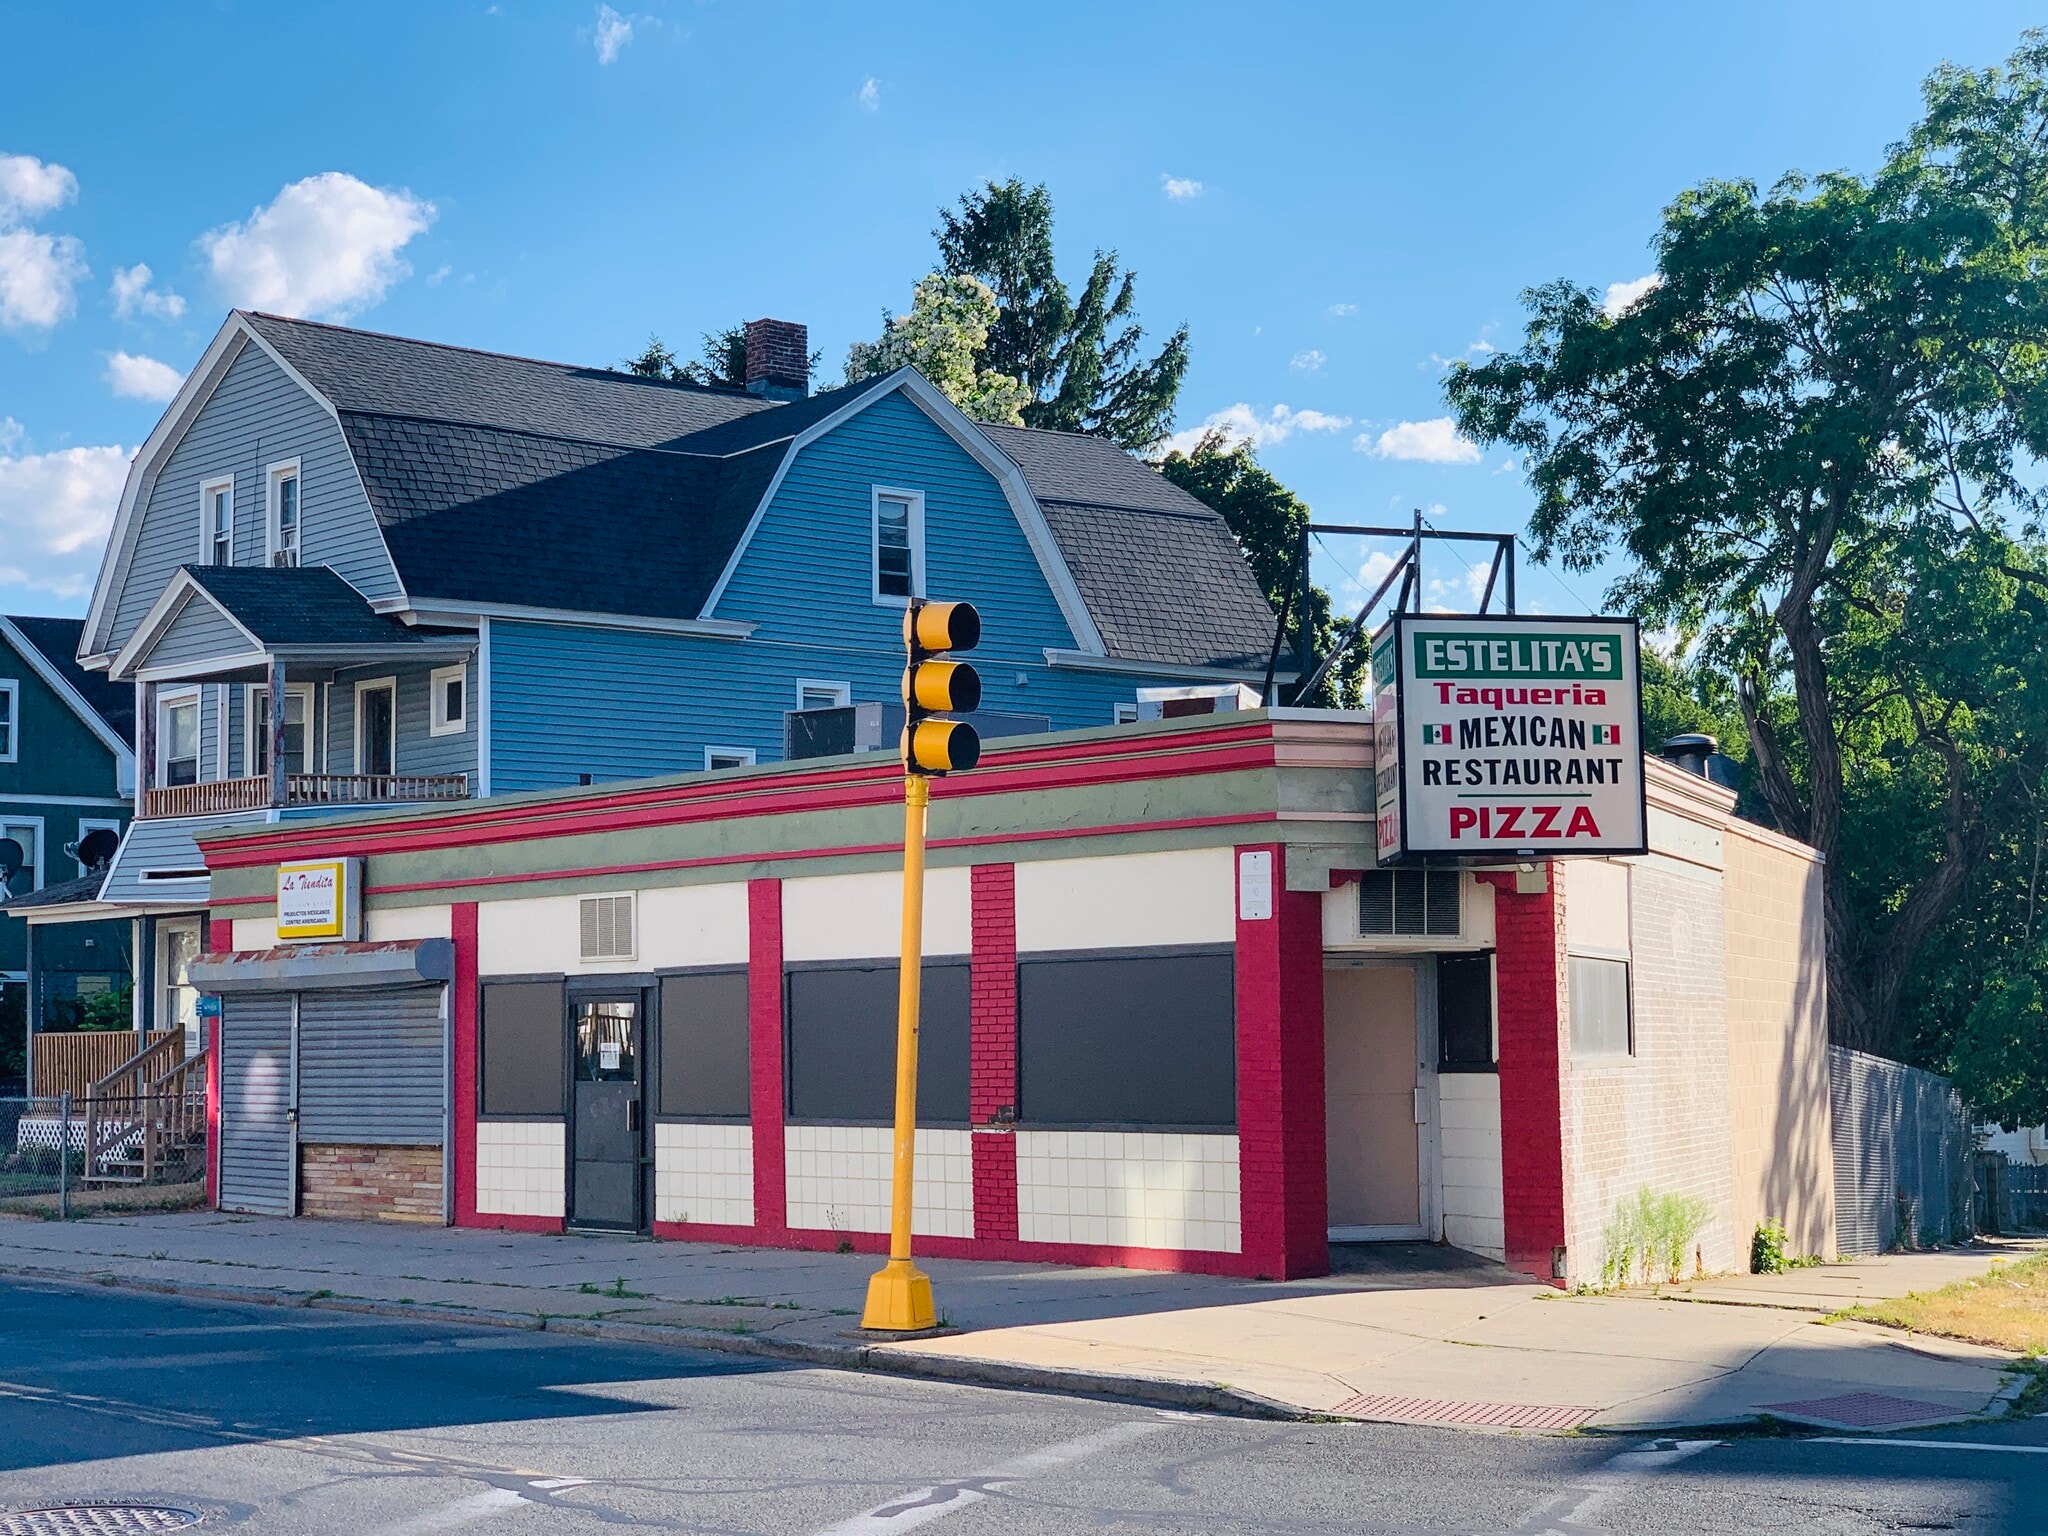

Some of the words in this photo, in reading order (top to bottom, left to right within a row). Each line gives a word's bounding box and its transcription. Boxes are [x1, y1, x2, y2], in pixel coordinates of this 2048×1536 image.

[1425, 639, 1612, 672] ESTELITA'S
[1433, 682, 1606, 710] Taqueria
[1459, 715, 1586, 750] MEXICAN
[1423, 758, 1623, 785] RESTAURANT
[1450, 806, 1602, 839] PIZZA
[282, 875, 294, 891] La
[299, 874, 333, 890] Tiendita
